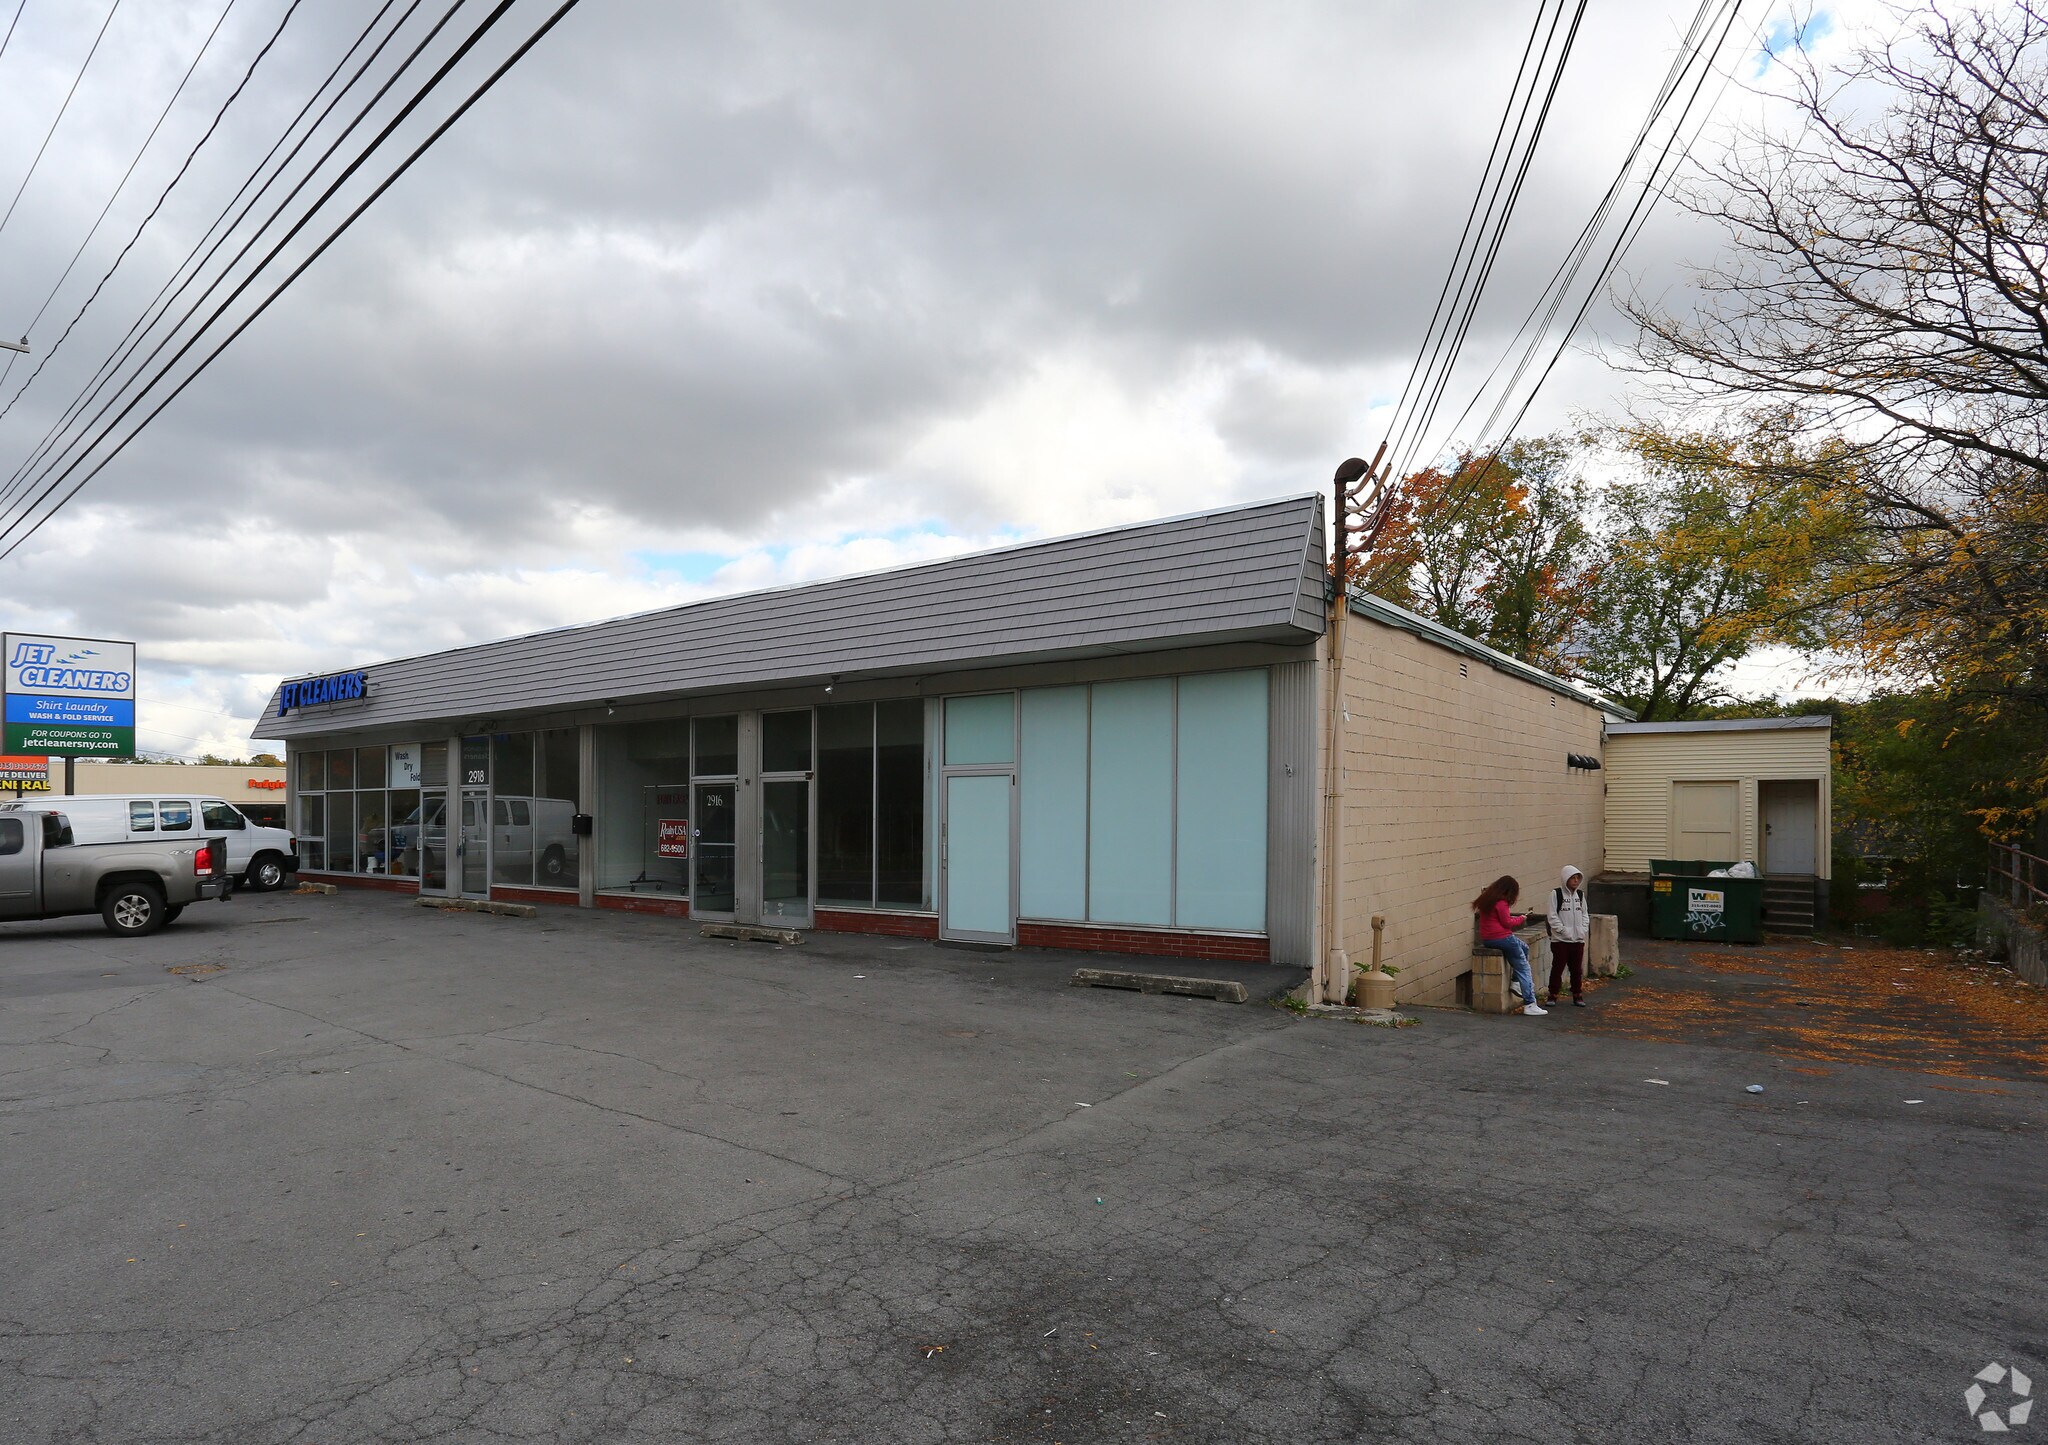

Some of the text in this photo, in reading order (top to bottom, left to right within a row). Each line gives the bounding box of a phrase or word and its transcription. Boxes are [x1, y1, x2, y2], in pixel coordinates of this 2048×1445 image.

[10, 643, 55, 667] JET
[19, 666, 131, 692] CLEANERS
[277, 671, 366, 717] JET CLEANERS
[36, 700, 108, 714] Shirt Laundry
[29, 712, 53, 720] WASH
[63, 713, 82, 721] FOLD
[83, 714, 114, 722] SERVICE
[49, 730, 87, 738] COUPONS
[89, 731, 100, 739] GO
[23, 738, 119, 749] jetcleanersny.com
[395, 751, 409, 760] Wash
[404, 762, 413, 772] Dry
[410, 772, 420, 781] Fold
[468, 770, 485, 783] 2918
[707, 794, 723, 807] 2916
